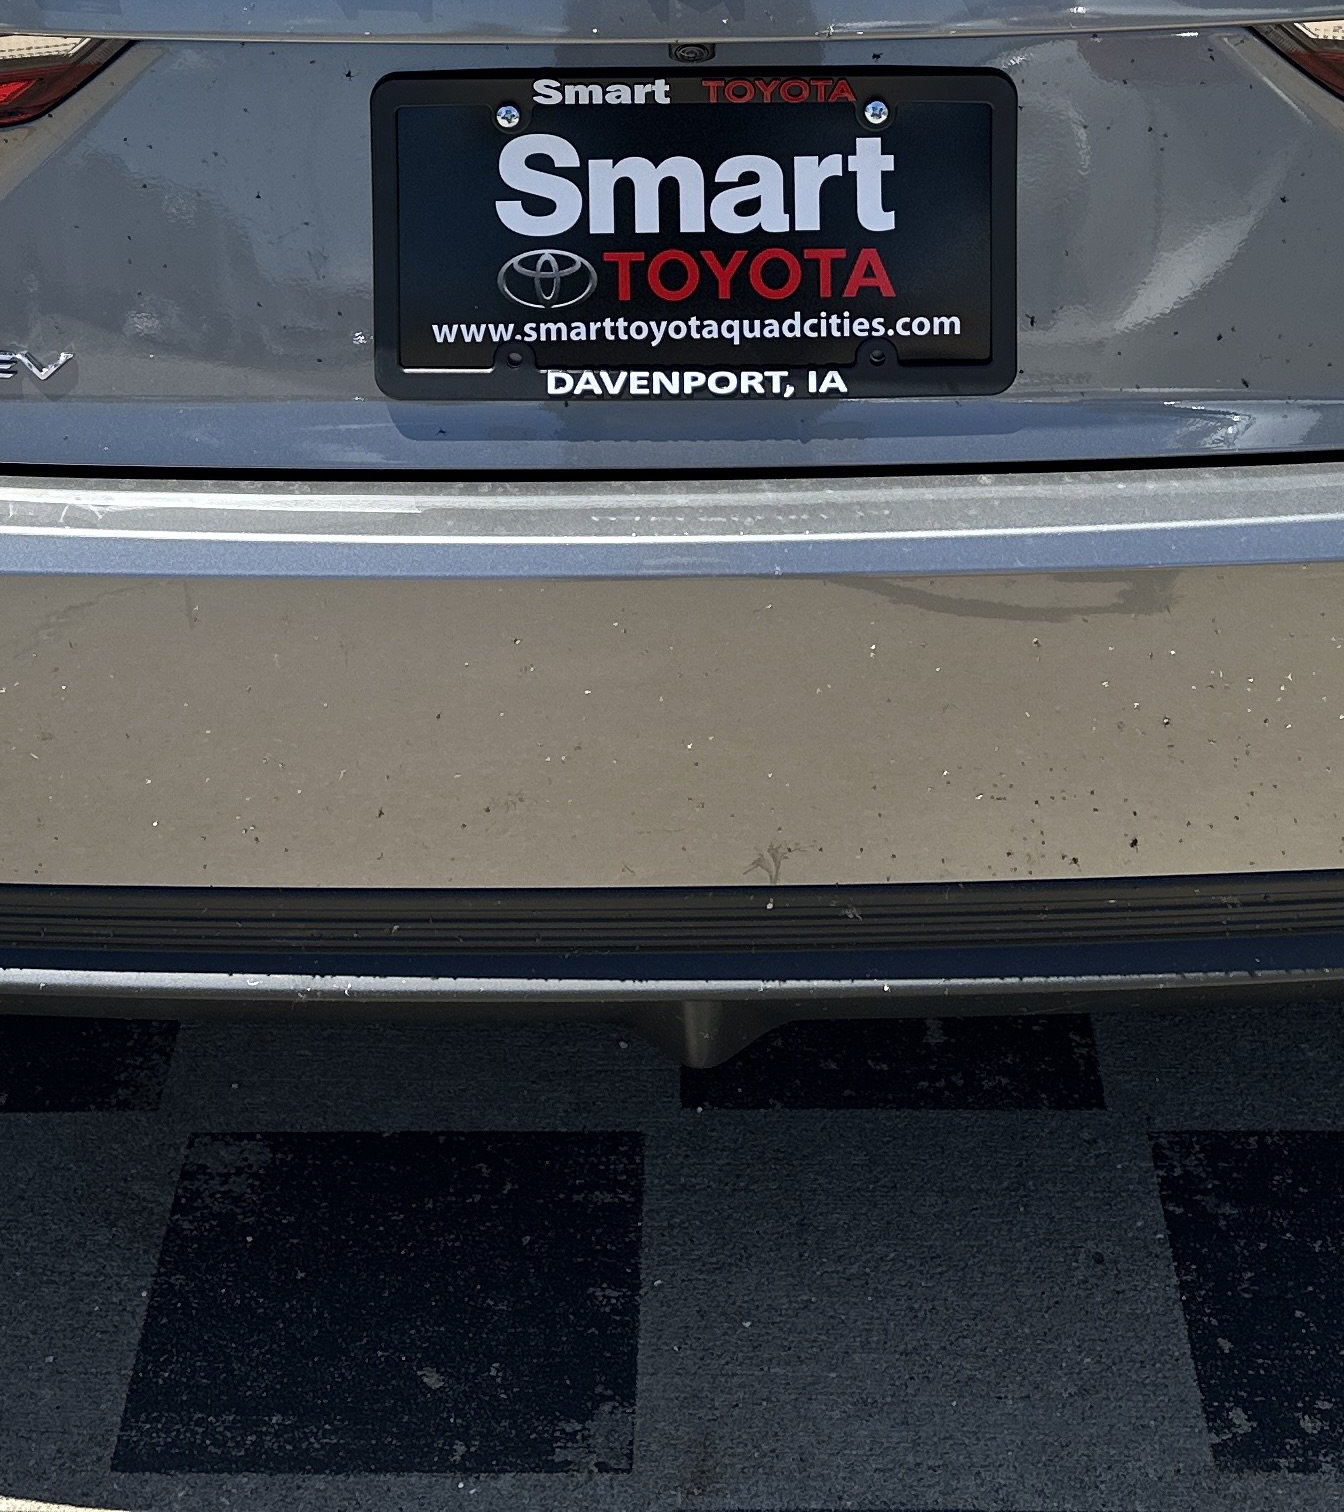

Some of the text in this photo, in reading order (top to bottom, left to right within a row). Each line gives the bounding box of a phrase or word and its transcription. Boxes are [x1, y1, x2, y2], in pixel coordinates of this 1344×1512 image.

[532, 78, 857, 105] Smart TOYOTA
[494, 133, 896, 237] Smart
[602, 247, 897, 302] TOYOTA
[431, 310, 962, 347] www.smarttoyotaquadcities.com
[545, 370, 849, 398] DAVENPORT, IA
